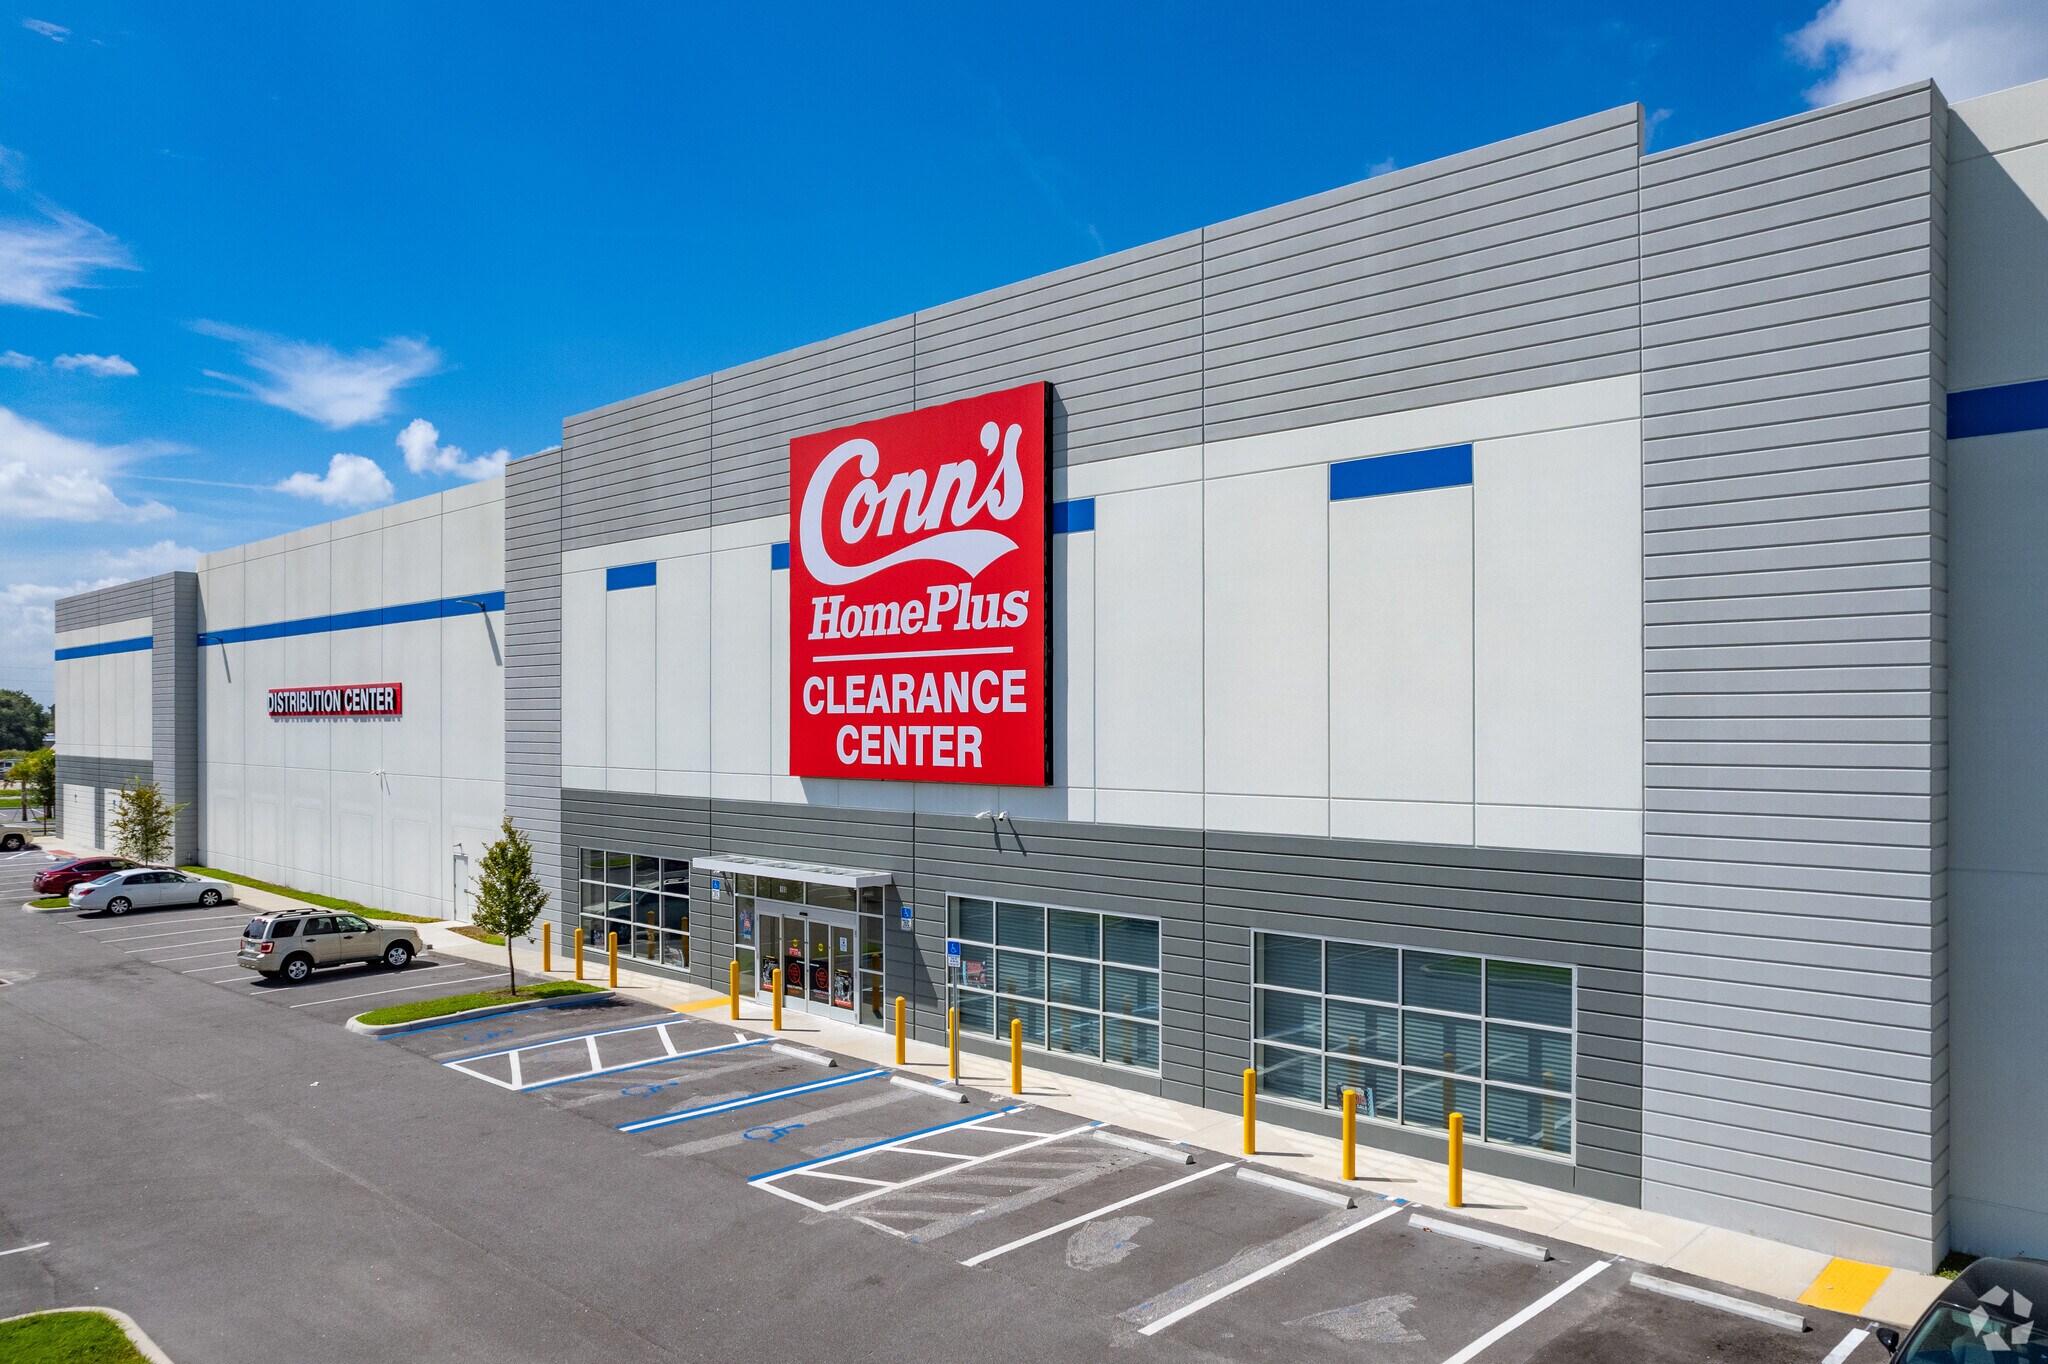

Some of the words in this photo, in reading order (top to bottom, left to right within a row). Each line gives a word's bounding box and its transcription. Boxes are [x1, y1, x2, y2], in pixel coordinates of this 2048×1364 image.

[800, 422, 1023, 585] Conn's
[808, 583, 1029, 640] HomePlus
[267, 689, 341, 713] DISTRIBUTION
[344, 687, 394, 711] CENTER
[803, 670, 1027, 715] CLEARANCE
[836, 725, 982, 768] CENTER
